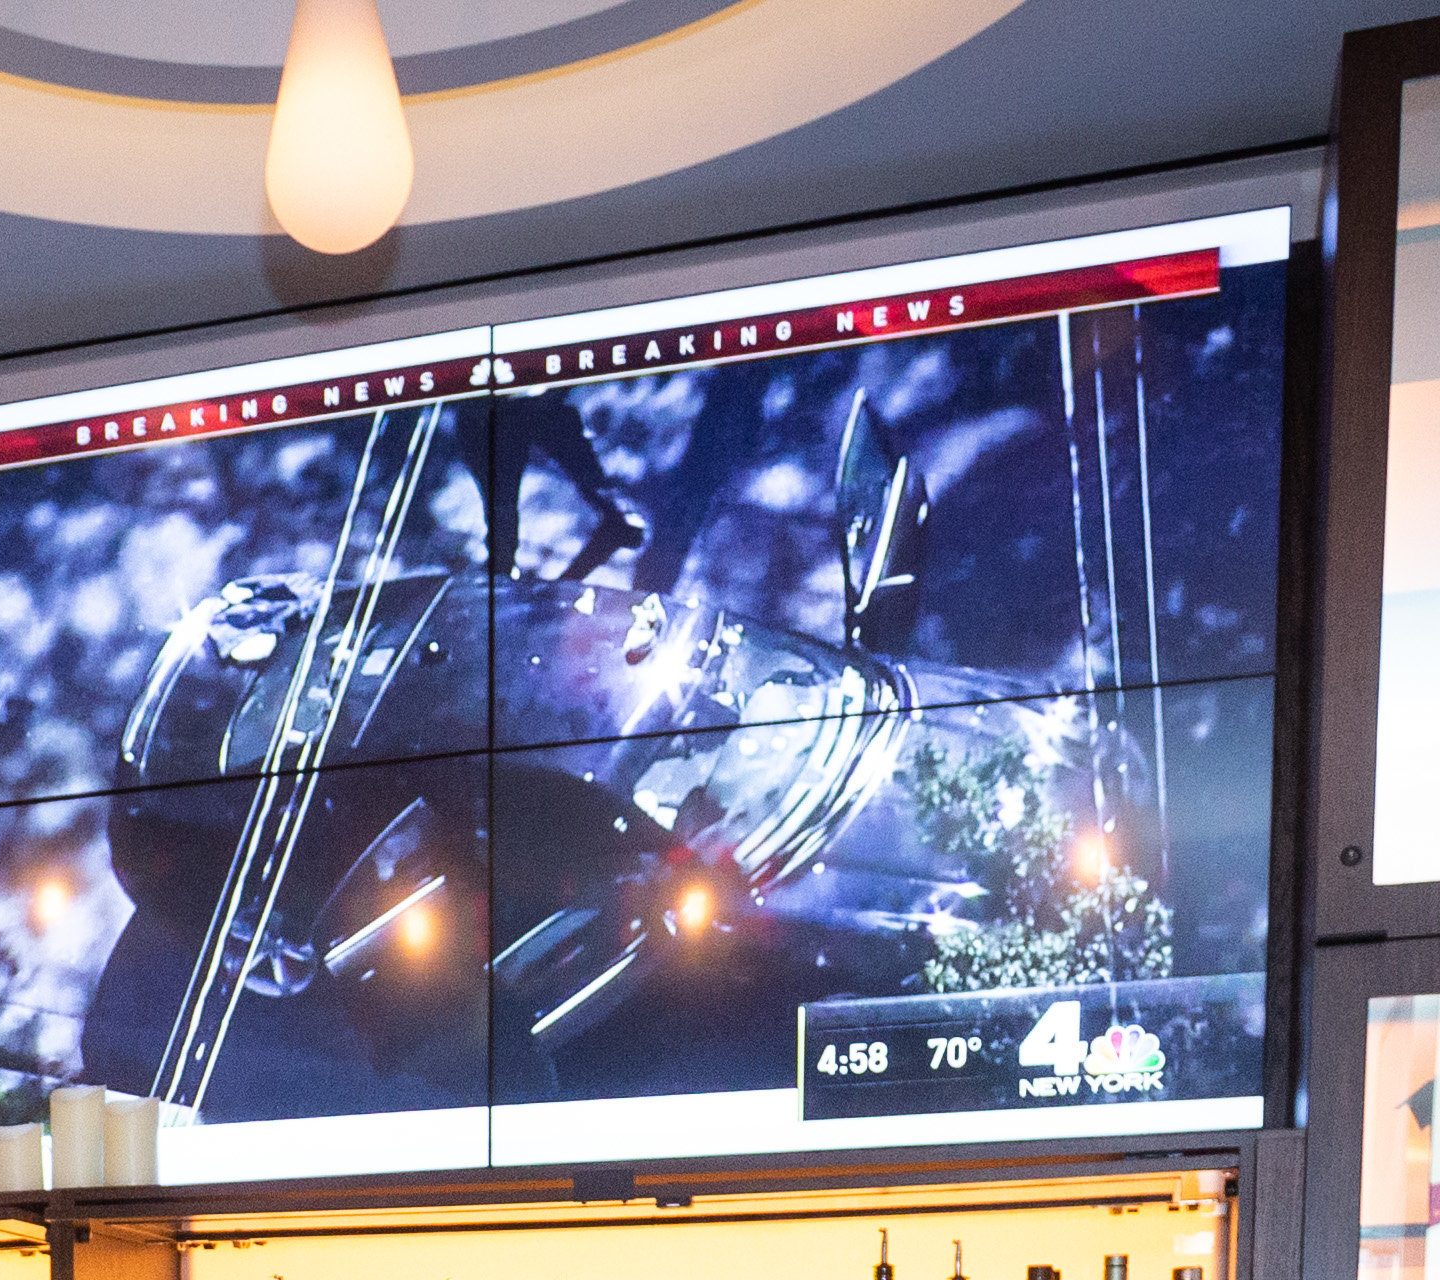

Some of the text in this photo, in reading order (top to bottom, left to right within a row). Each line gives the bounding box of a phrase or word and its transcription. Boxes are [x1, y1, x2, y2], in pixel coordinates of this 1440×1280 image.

[545, 295, 966, 376] BREAKING NEWS
[75, 371, 434, 445] BREAKING NEWS
[816, 1041, 889, 1075] 4:58
[1019, 1000, 1088, 1076] 4
[1019, 1070, 1165, 1098] NEW YORK
